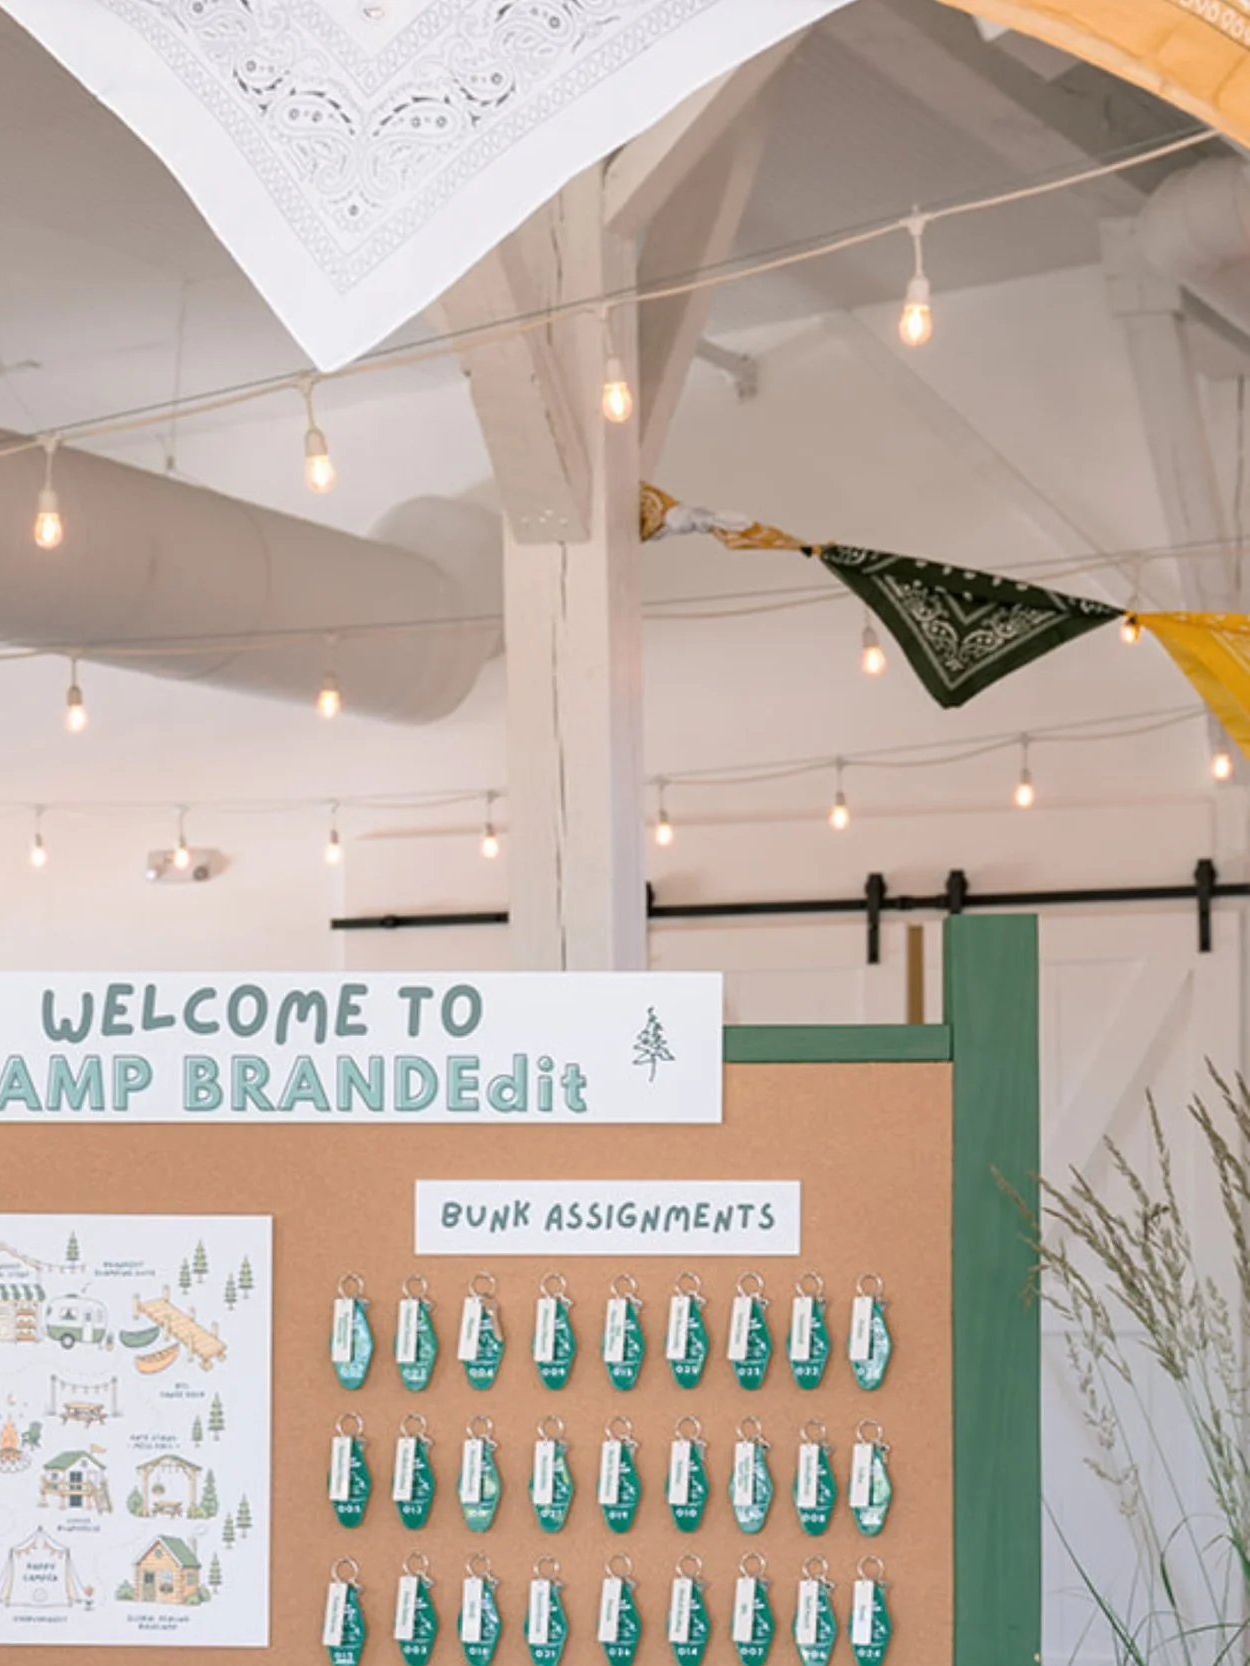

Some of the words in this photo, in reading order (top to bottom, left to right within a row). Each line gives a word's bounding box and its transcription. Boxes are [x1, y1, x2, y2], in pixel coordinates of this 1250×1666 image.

[42, 984, 369, 1047] WELCOME
[398, 985, 483, 1039] TO
[182, 1053, 589, 1114] BRANDEdit
[441, 1201, 531, 1233] BUNK
[545, 1202, 776, 1234] ASSIGNMENTS
